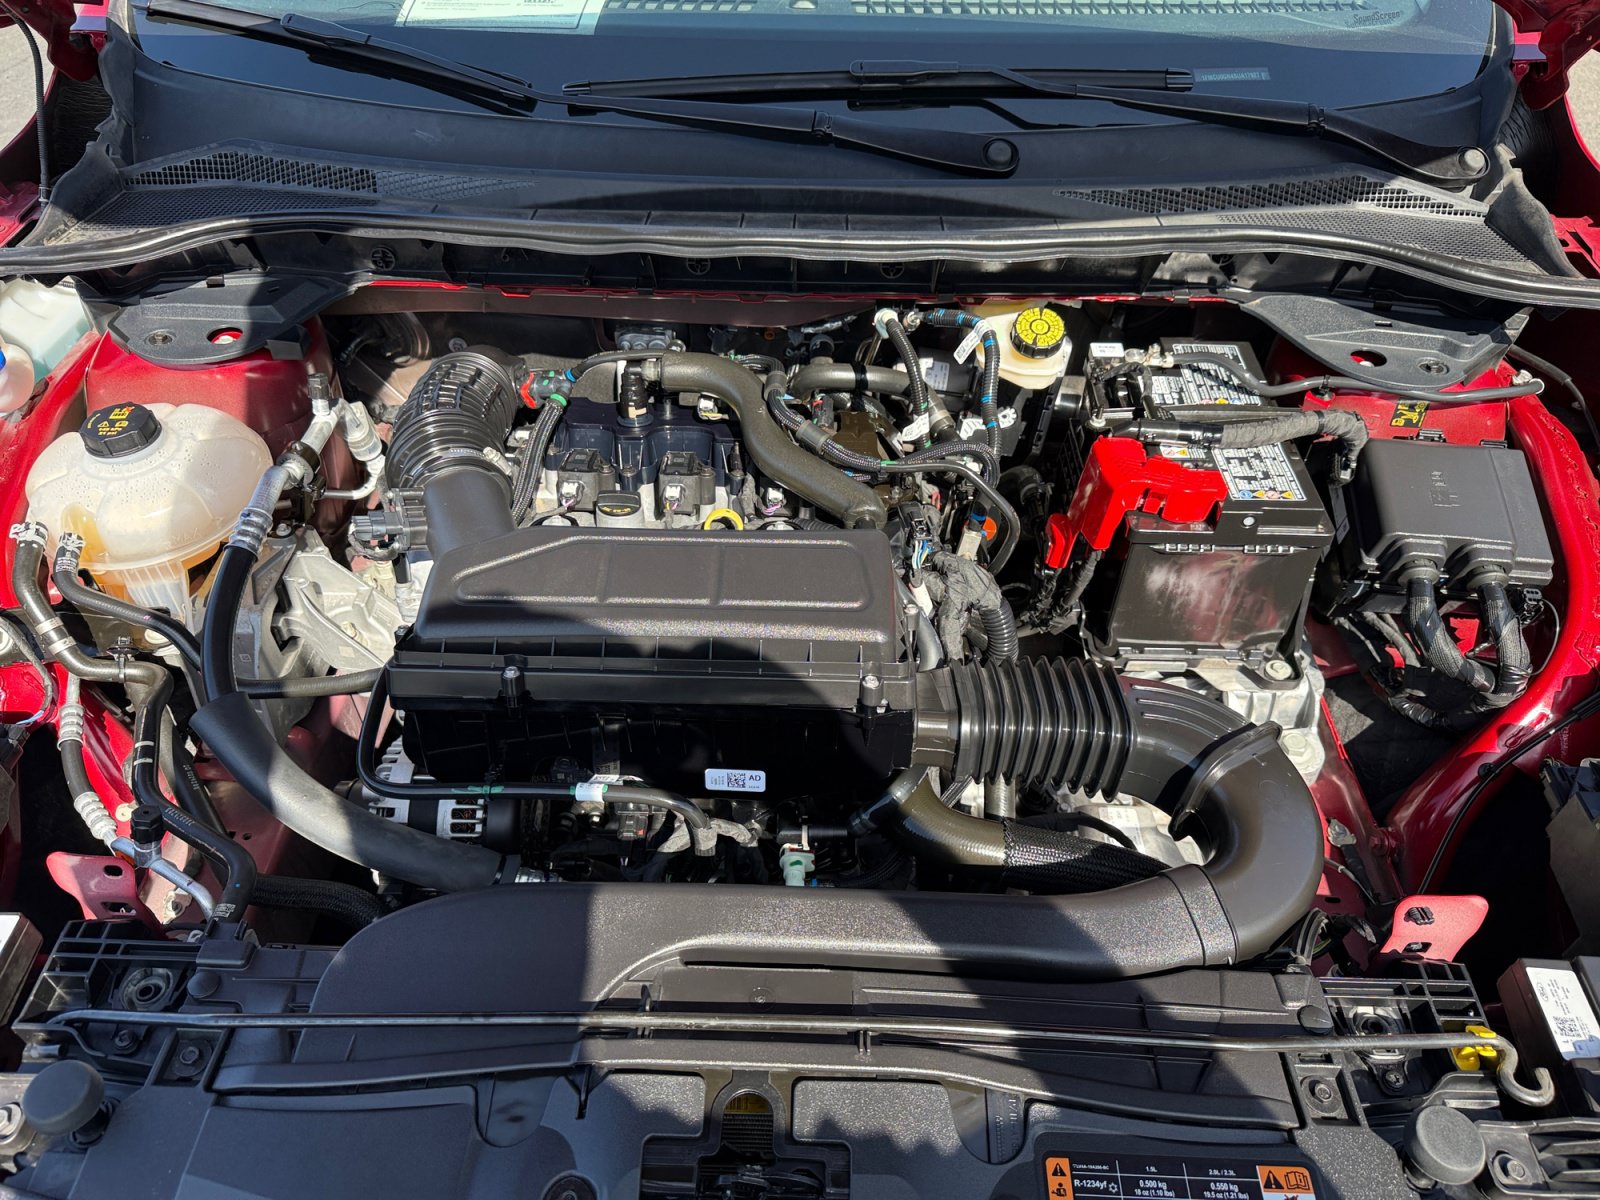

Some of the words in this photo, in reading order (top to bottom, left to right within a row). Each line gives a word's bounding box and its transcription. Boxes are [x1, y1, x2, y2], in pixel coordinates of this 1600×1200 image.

[748, 774, 762, 782] AD
[1074, 1179, 1107, 1190] R-1234yf
[1138, 1179, 1157, 1188] 0.500
[1157, 1180, 1167, 1190] kg
[1210, 1182, 1228, 1191] 0.550
[1229, 1183, 1239, 1192] kg
